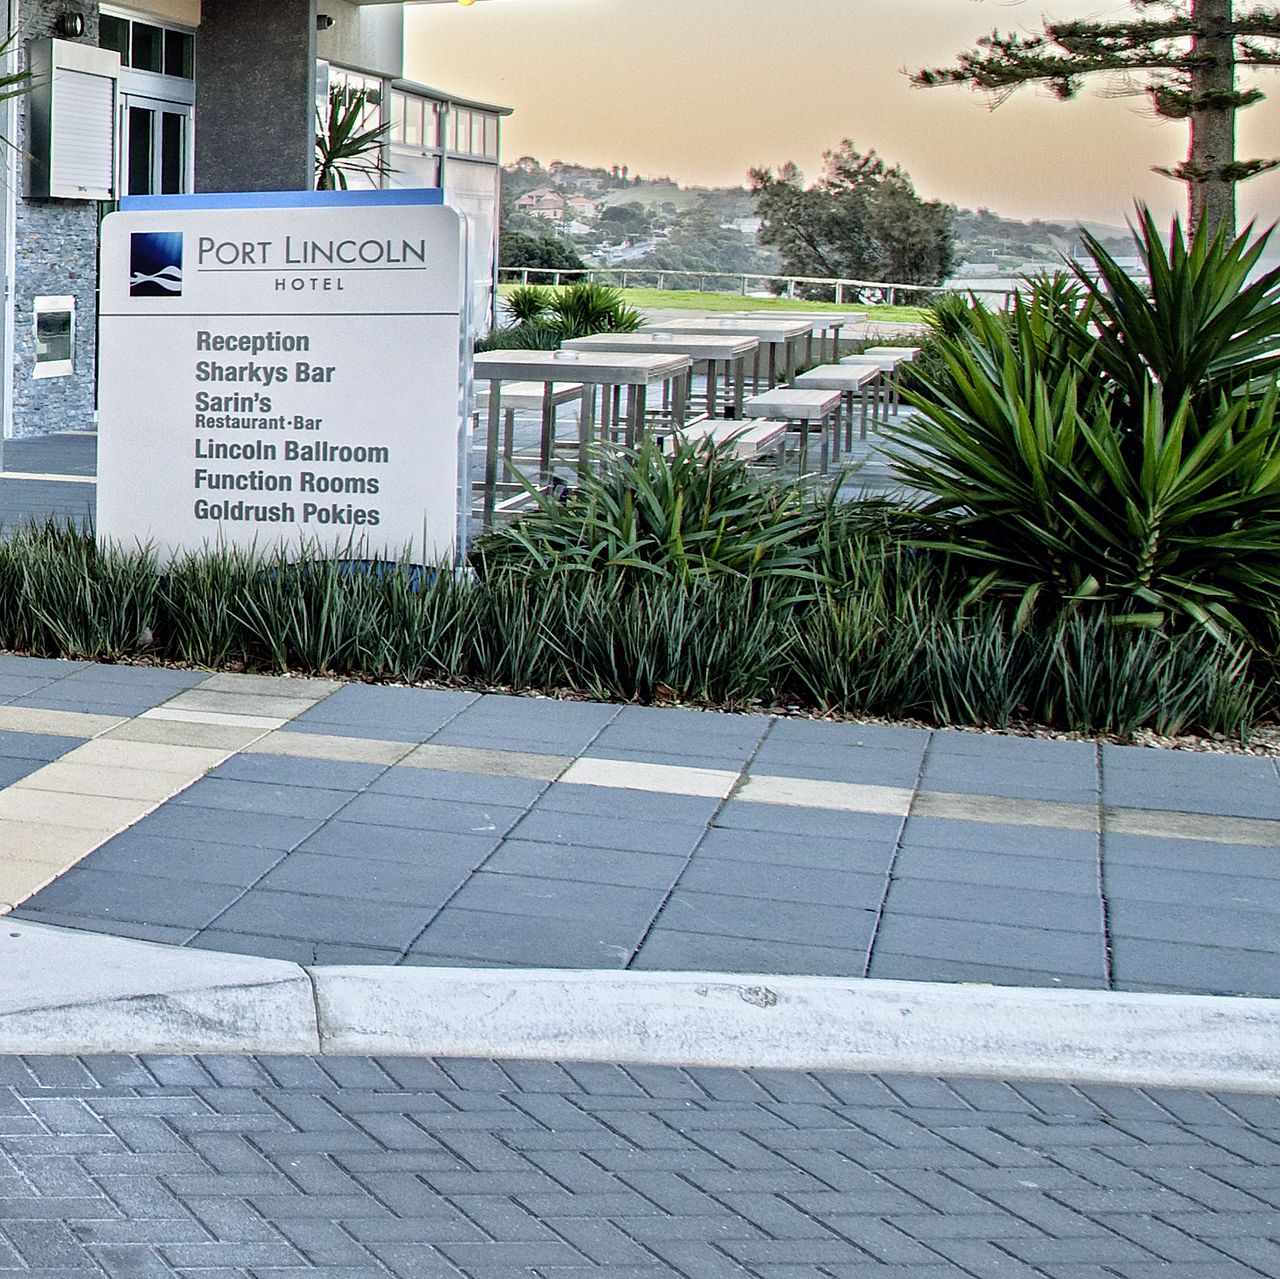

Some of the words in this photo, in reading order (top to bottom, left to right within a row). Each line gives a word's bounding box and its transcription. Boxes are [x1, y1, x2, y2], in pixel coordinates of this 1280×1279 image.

[197, 236, 272, 266] PORT
[285, 235, 427, 264] LINCOLN
[274, 278, 345, 291] HOTEL
[196, 331, 310, 356] Reception
[195, 361, 288, 387] Sharkys
[294, 362, 336, 384] Bar
[195, 391, 272, 413] Sarin's
[194, 438, 277, 461] Lincoln
[284, 439, 389, 464] Ballroom
[194, 468, 293, 493] Function
[299, 471, 380, 495] Rooms
[194, 498, 295, 523] Goldrush
[302, 501, 381, 527] Pokies
